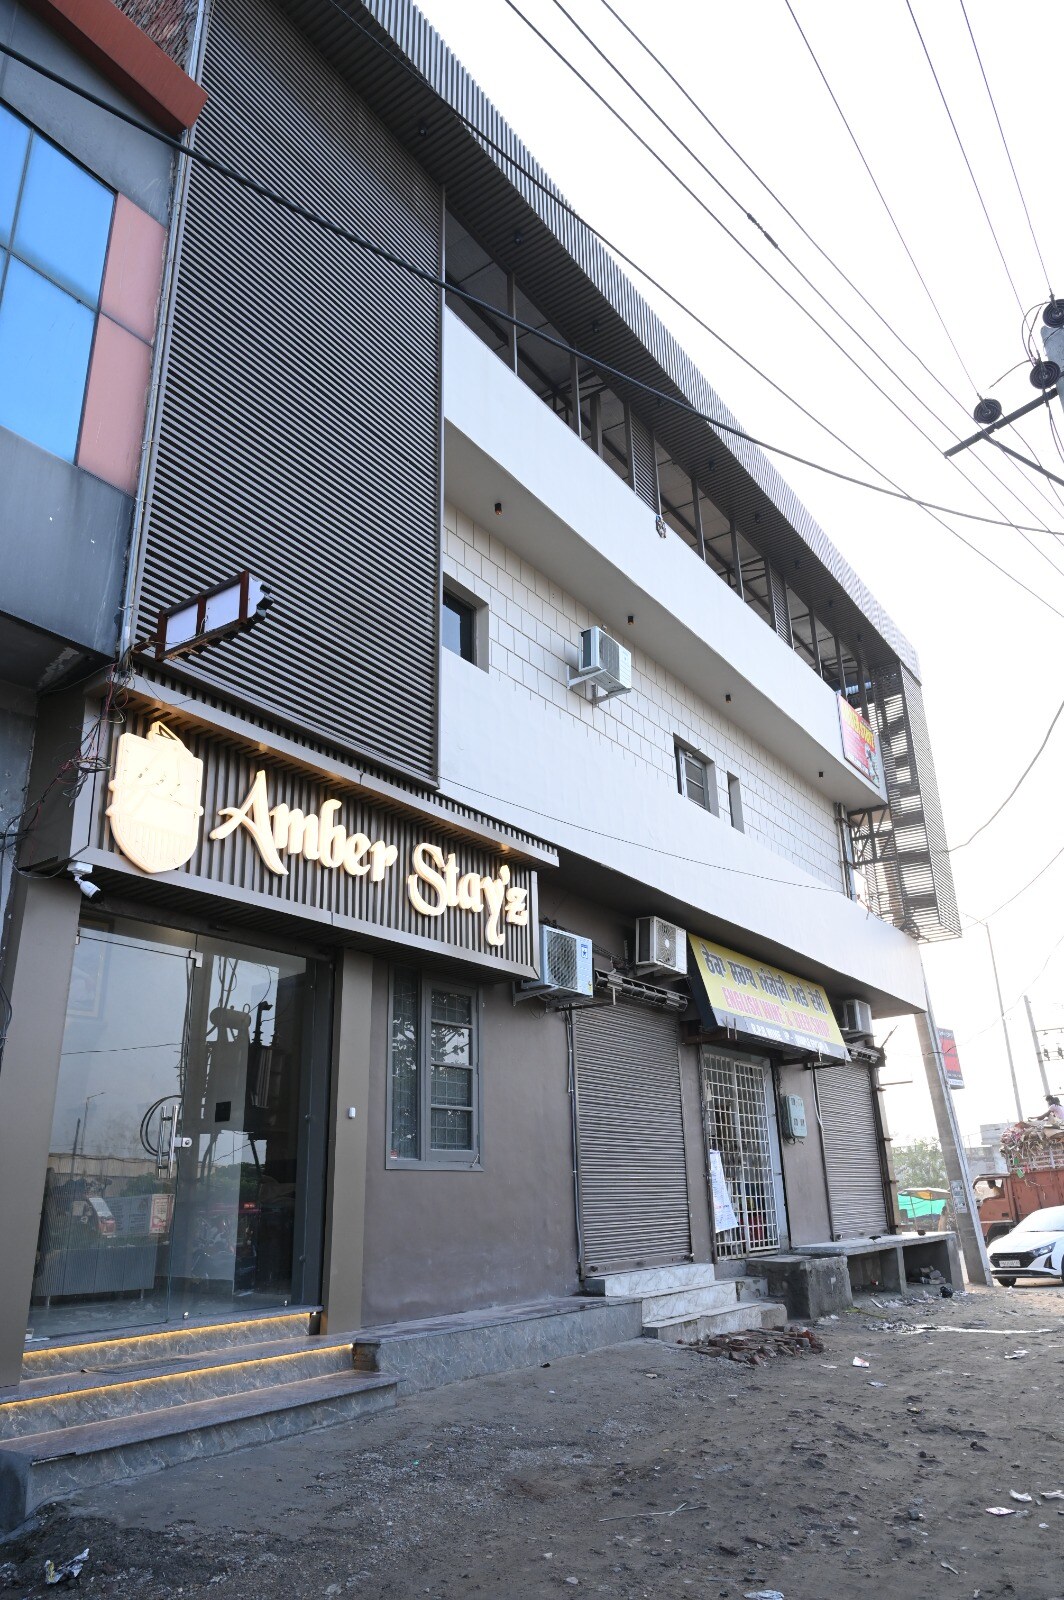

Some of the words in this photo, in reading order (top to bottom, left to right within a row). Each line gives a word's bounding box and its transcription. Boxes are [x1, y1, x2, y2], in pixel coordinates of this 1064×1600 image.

[209, 769, 398, 882] Amber
[408, 843, 528, 946] Stay'z
[722, 987, 762, 1016] ENGLISH
[759, 1000, 785, 1024] WINE
[784, 1011, 793, 1026] &
[791, 1010, 812, 1033] BEER
[809, 1016, 831, 1037] SHOP
